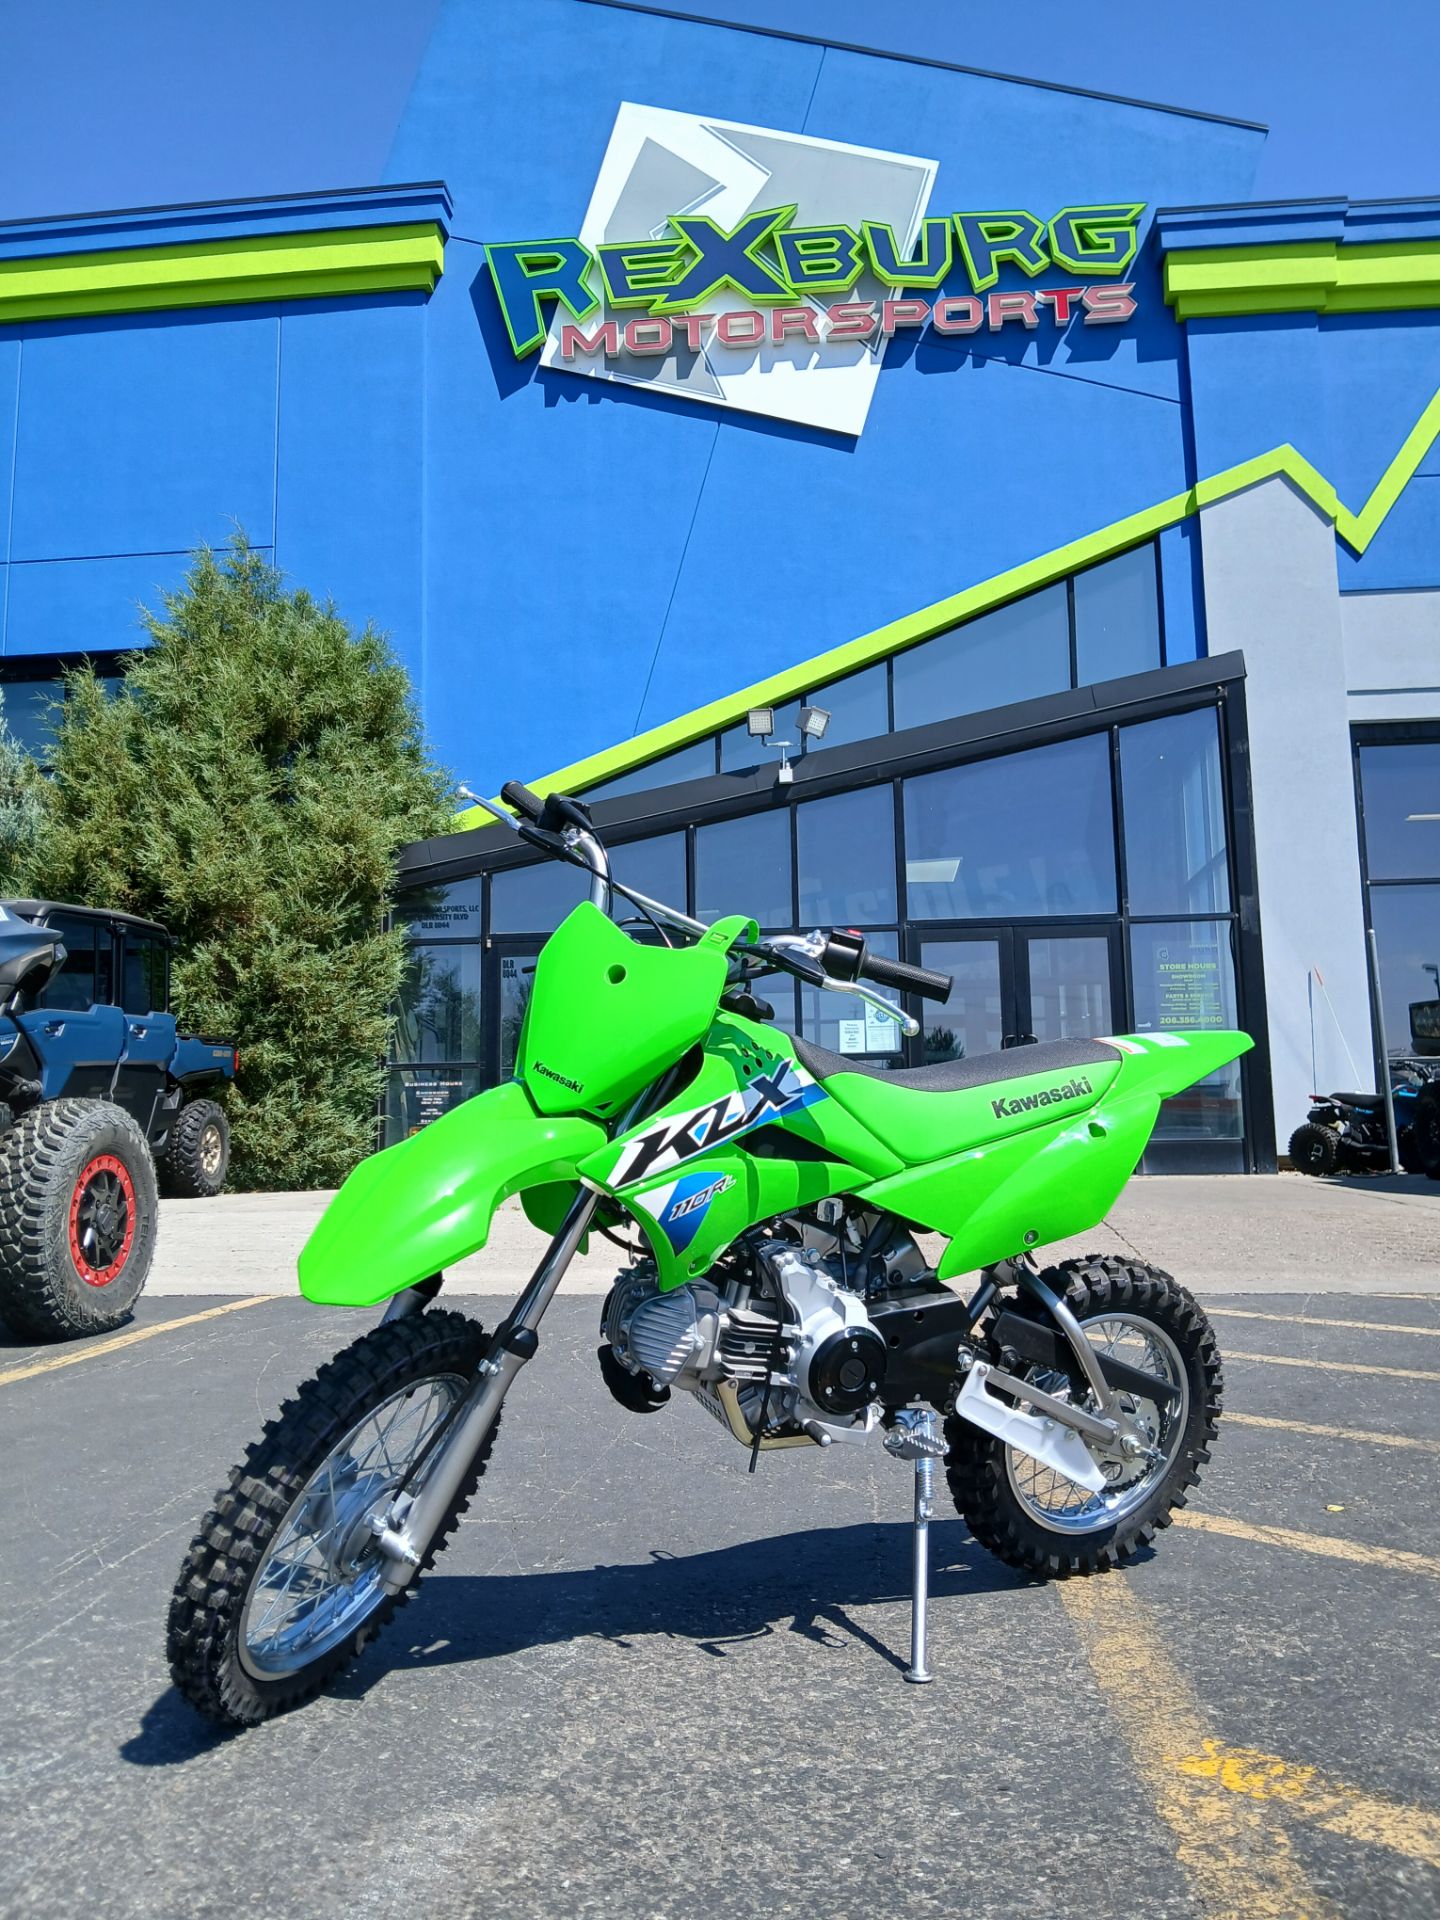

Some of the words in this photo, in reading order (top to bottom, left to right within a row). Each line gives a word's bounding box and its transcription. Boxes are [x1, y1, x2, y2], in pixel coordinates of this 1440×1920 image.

[483, 202, 1148, 361] REXBURG
[560, 282, 1138, 362] MOTORSPORTS
[468, 904, 480, 913] LLC
[502, 959, 515, 969] DLR
[533, 1060, 585, 1094] Kawasaki
[991, 1076, 1093, 1119] Kawasaki
[612, 1060, 803, 1188] KLX
